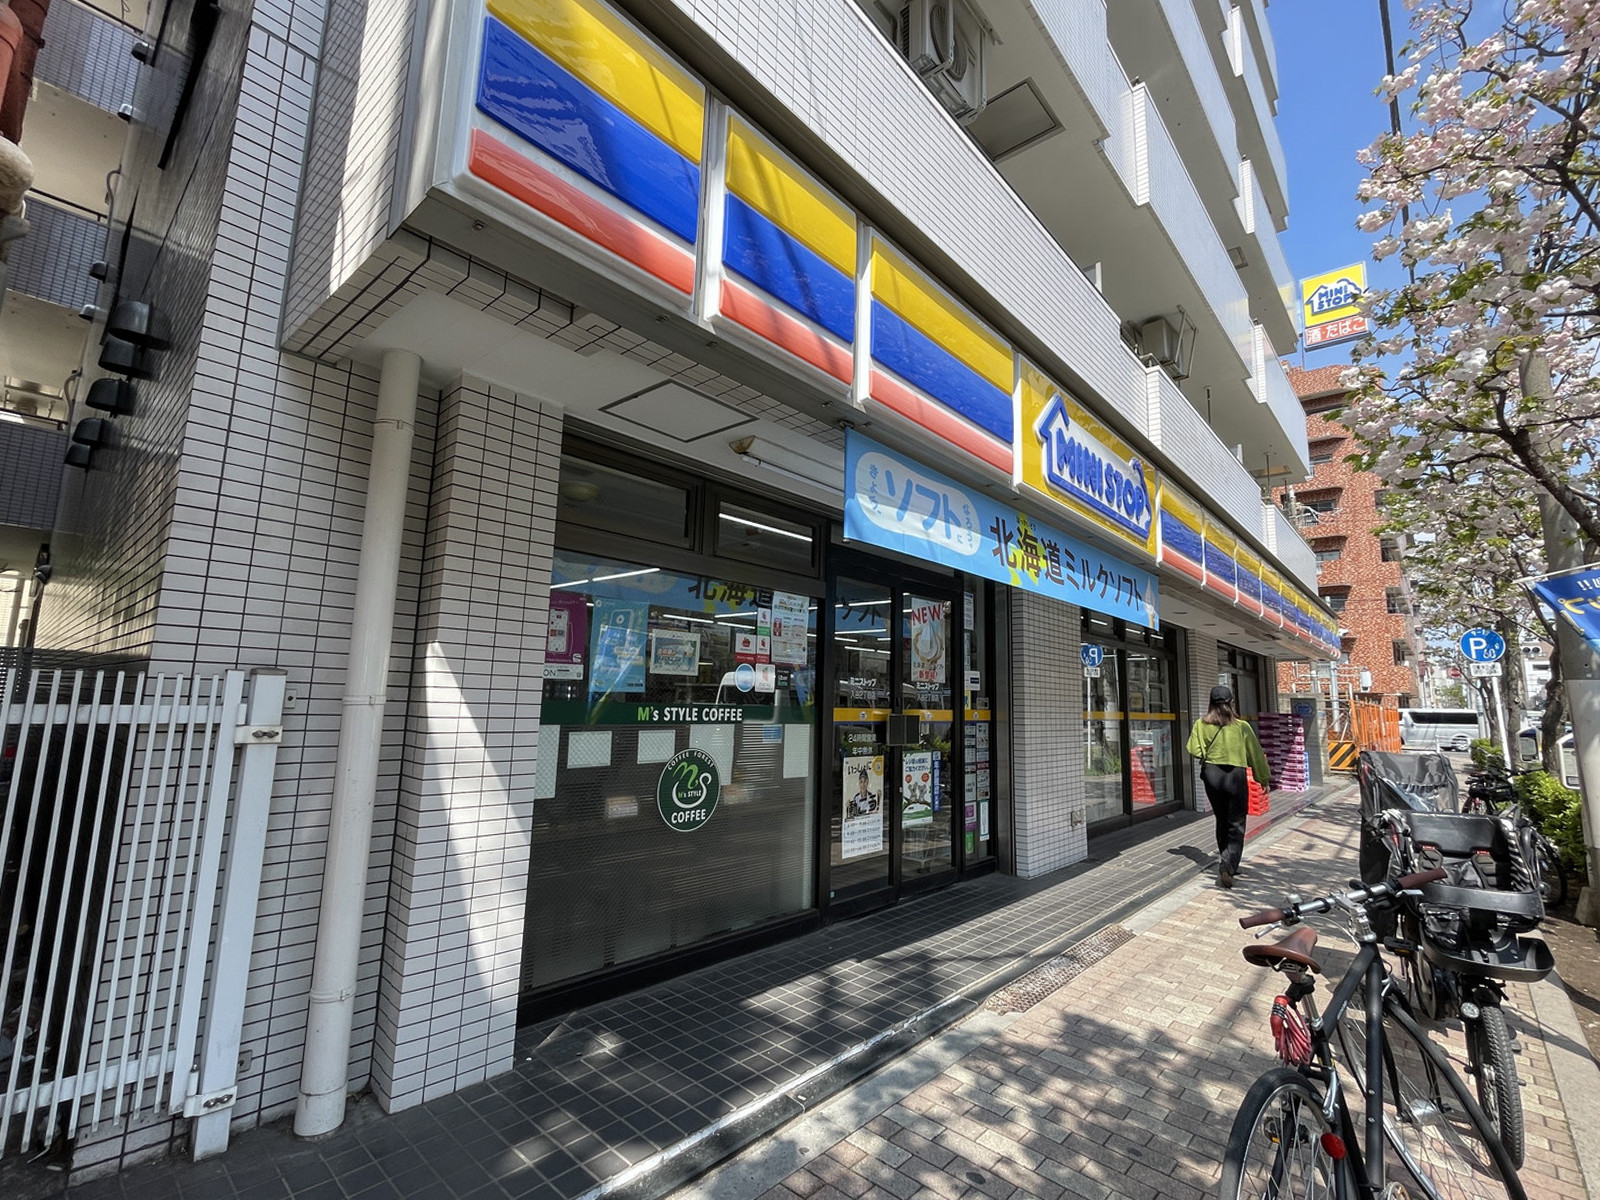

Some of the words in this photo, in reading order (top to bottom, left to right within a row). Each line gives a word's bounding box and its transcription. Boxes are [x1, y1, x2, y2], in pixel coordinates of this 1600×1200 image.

[1318, 285, 1349, 299] MINI
[885, 469, 962, 540] ソフト
[989, 516, 1143, 611] 北海道ミルクソフト
[1469, 637, 1487, 660] P
[850, 676, 877, 687] ミニストップ
[916, 681, 940, 691] ミニストップ
[637, 706, 659, 721] M's
[663, 706, 698, 722] STYLE
[702, 707, 743, 722] COFFEE
[667, 752, 690, 771] COFFEE
[693, 751, 714, 768] FOREST
[687, 790, 702, 798] STYLE
[671, 809, 706, 824] COFFEE
